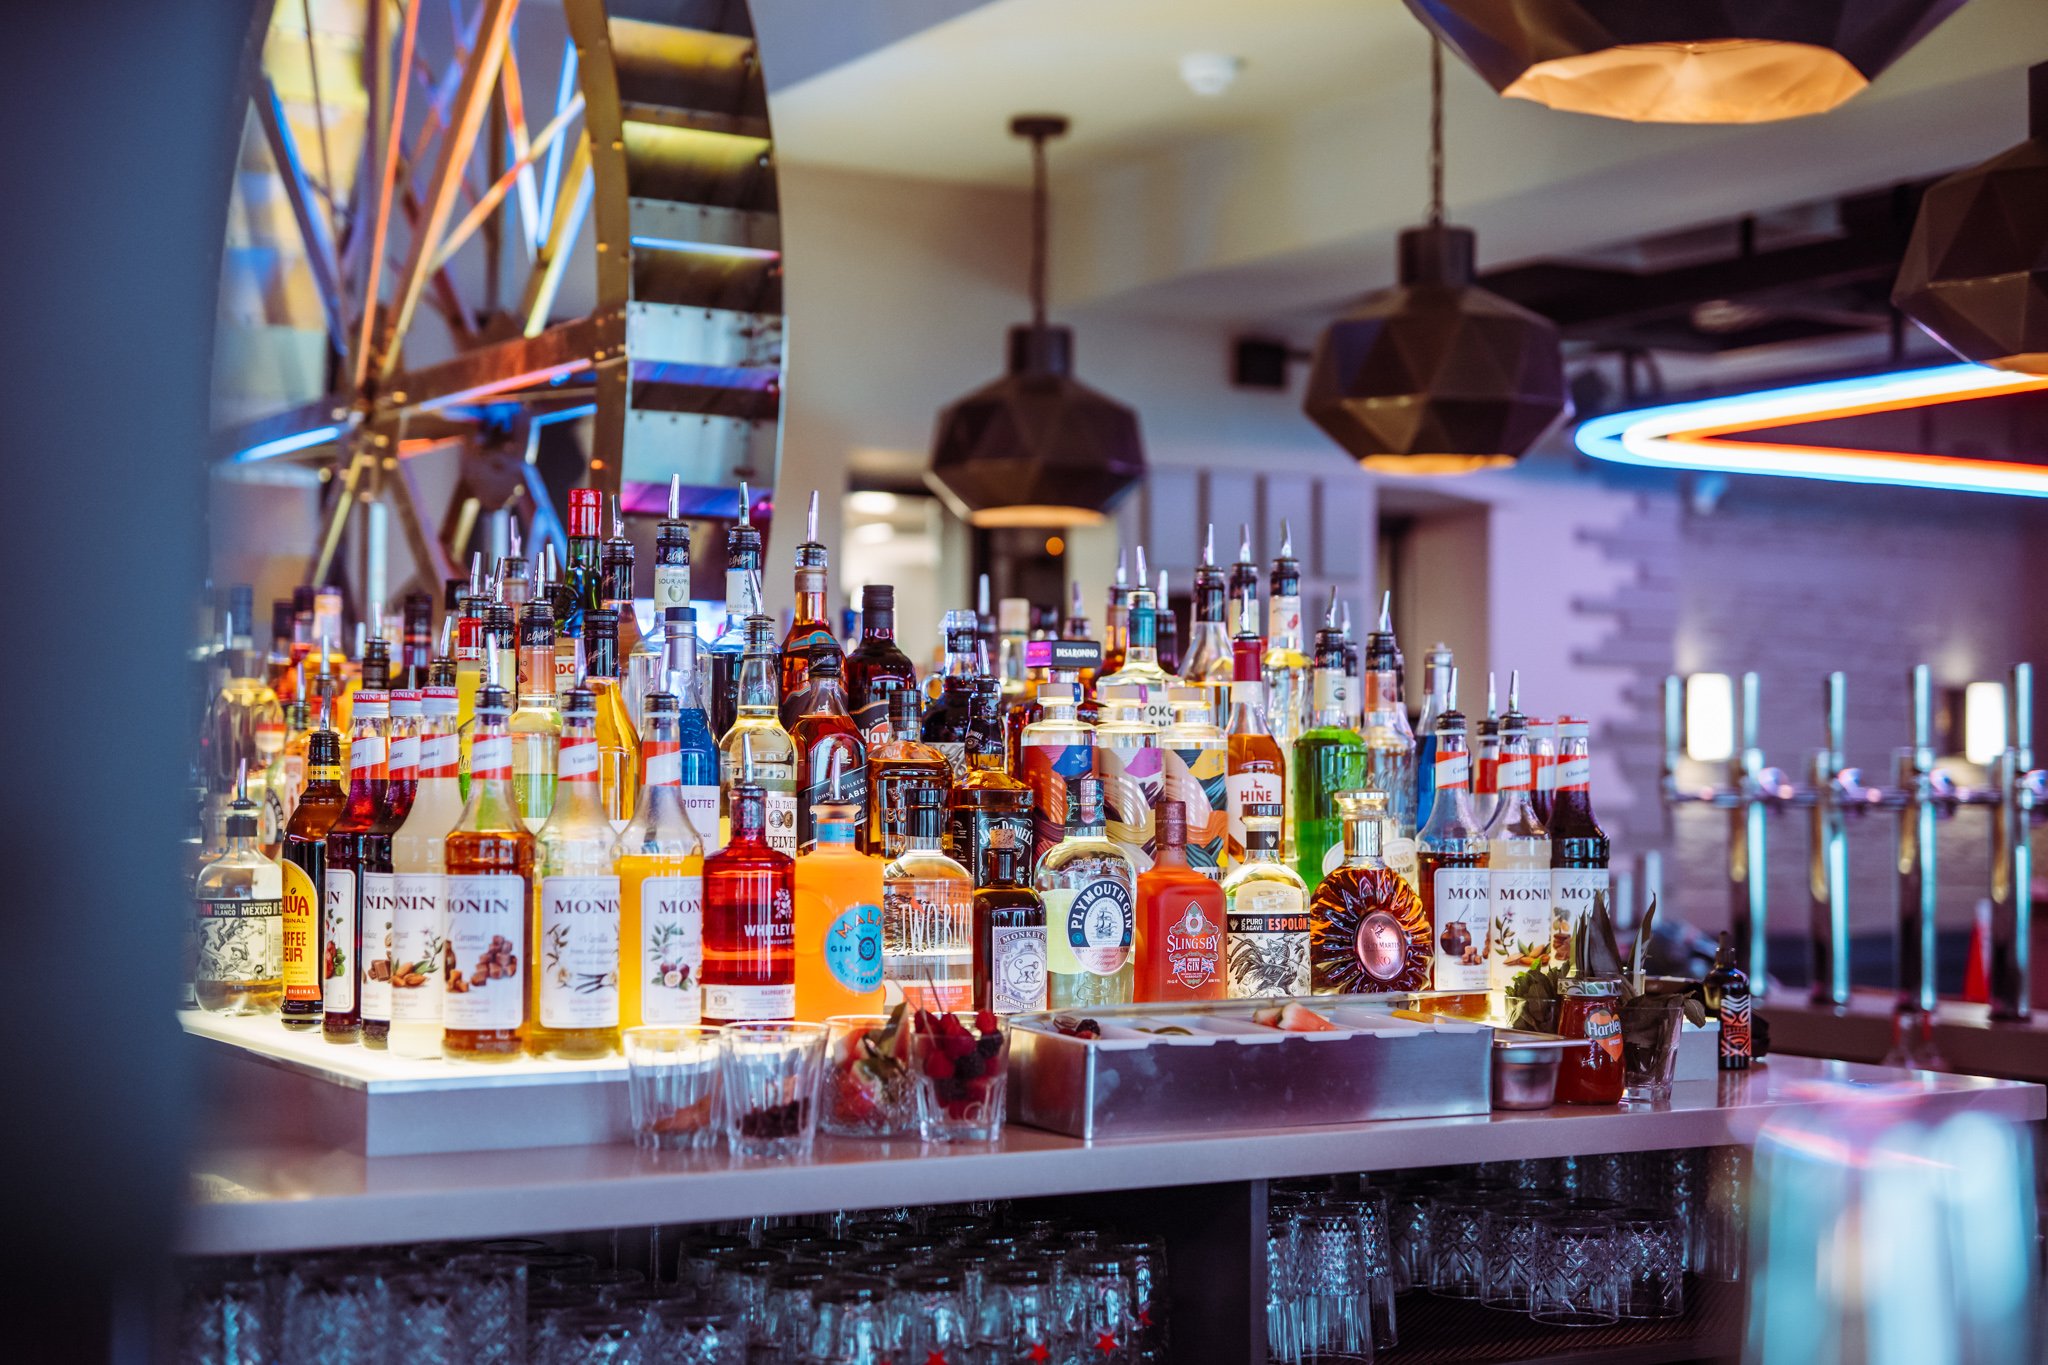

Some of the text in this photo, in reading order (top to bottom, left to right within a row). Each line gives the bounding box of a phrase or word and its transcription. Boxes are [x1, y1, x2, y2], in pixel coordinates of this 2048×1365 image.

[1056, 647, 1099, 659] DISARONNO
[1241, 791, 1272, 802] HINE
[1071, 883, 1132, 930] PLYMOUTH GIN
[898, 903, 939, 951] TWO
[1268, 914, 1307, 931] ESPOLÓN
[1001, 930, 1041, 945] MONKEY
[1167, 933, 1221, 953] SLINGSBY
[830, 945, 852, 953] GIN
[1186, 961, 1200, 972] GIN
